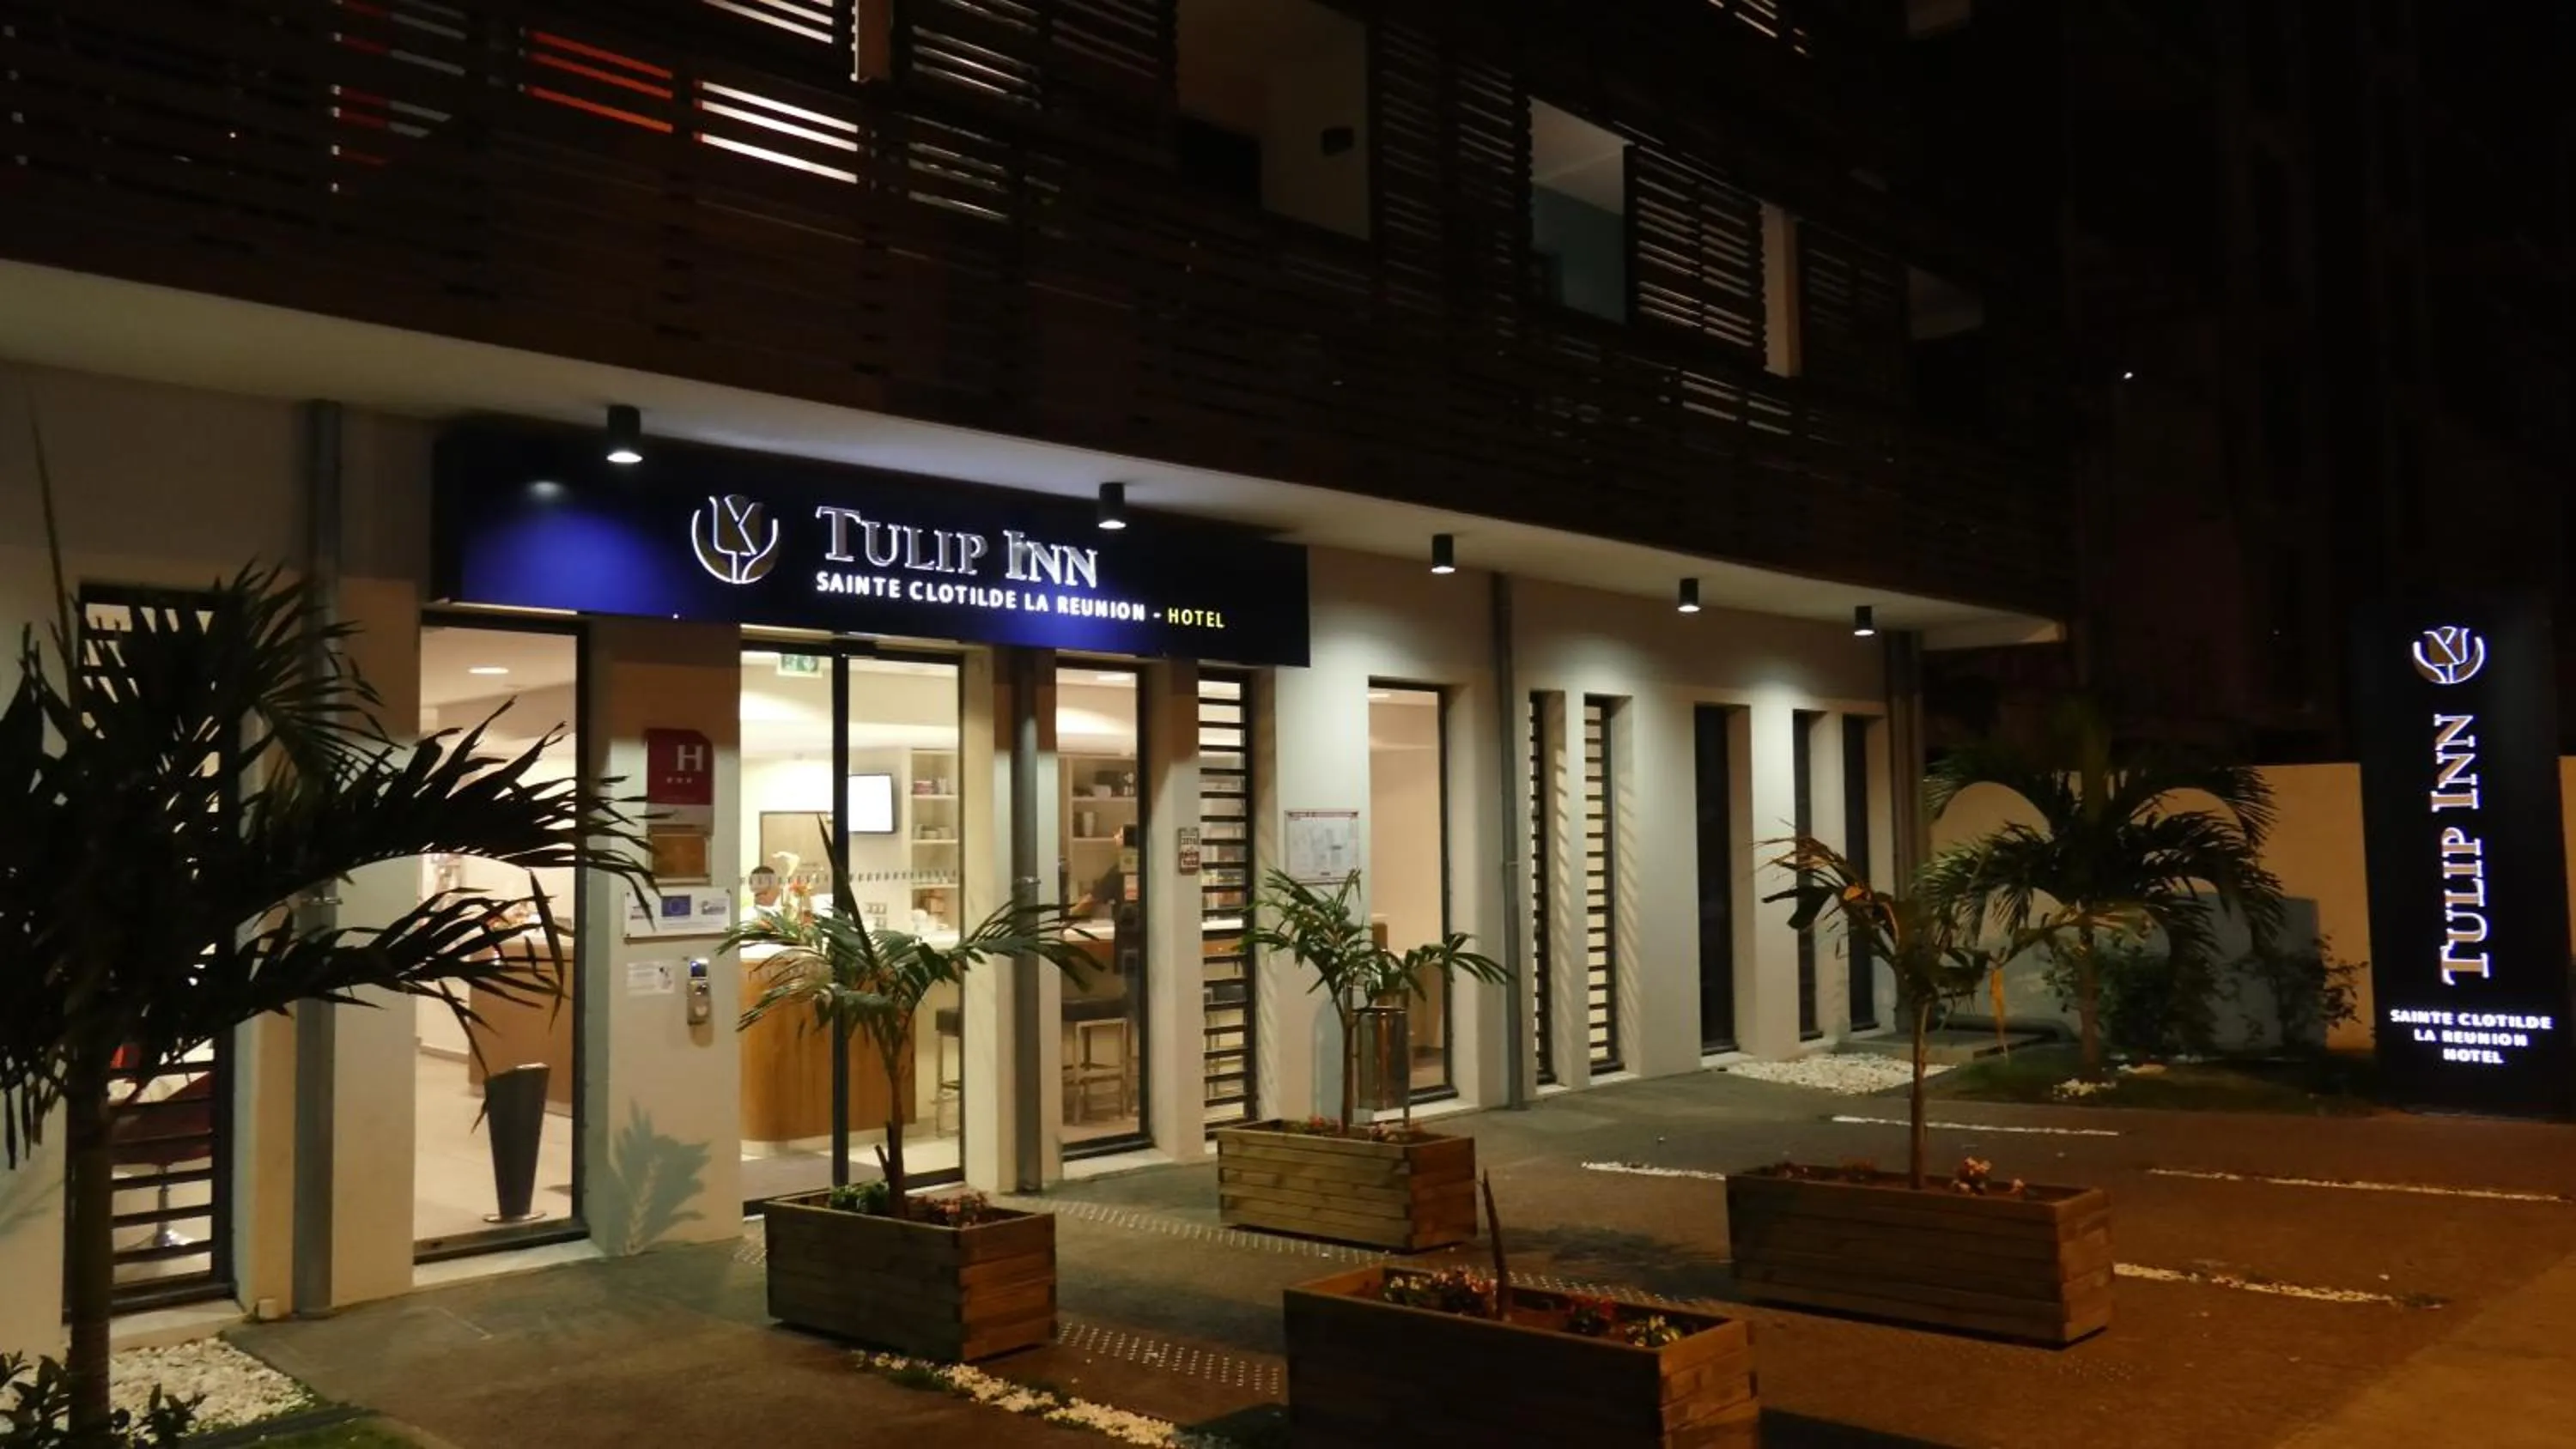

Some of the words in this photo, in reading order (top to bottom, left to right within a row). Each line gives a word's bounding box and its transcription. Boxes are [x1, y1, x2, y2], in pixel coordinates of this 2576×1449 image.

[816, 505, 989, 576] TULIP
[1002, 529, 1099, 589] INN
[816, 570, 902, 598] SAINTE
[908, 580, 1018, 609] CLOTILDE
[1024, 592, 1049, 613] LA
[1057, 595, 1145, 621] REUNION
[1168, 607, 1226, 629] HOTEL
[677, 744, 704, 772] H
[2431, 713, 2480, 813] INN
[2439, 826, 2490, 985] TULIP
[2390, 1009, 2455, 1026] SAINTE
[2457, 1012, 2554, 1030] CLOTILDE
[2414, 1028, 2437, 1042] LA
[2441, 1030, 2529, 1047] REUNION
[2442, 1047, 2505, 1064] HOTEL
